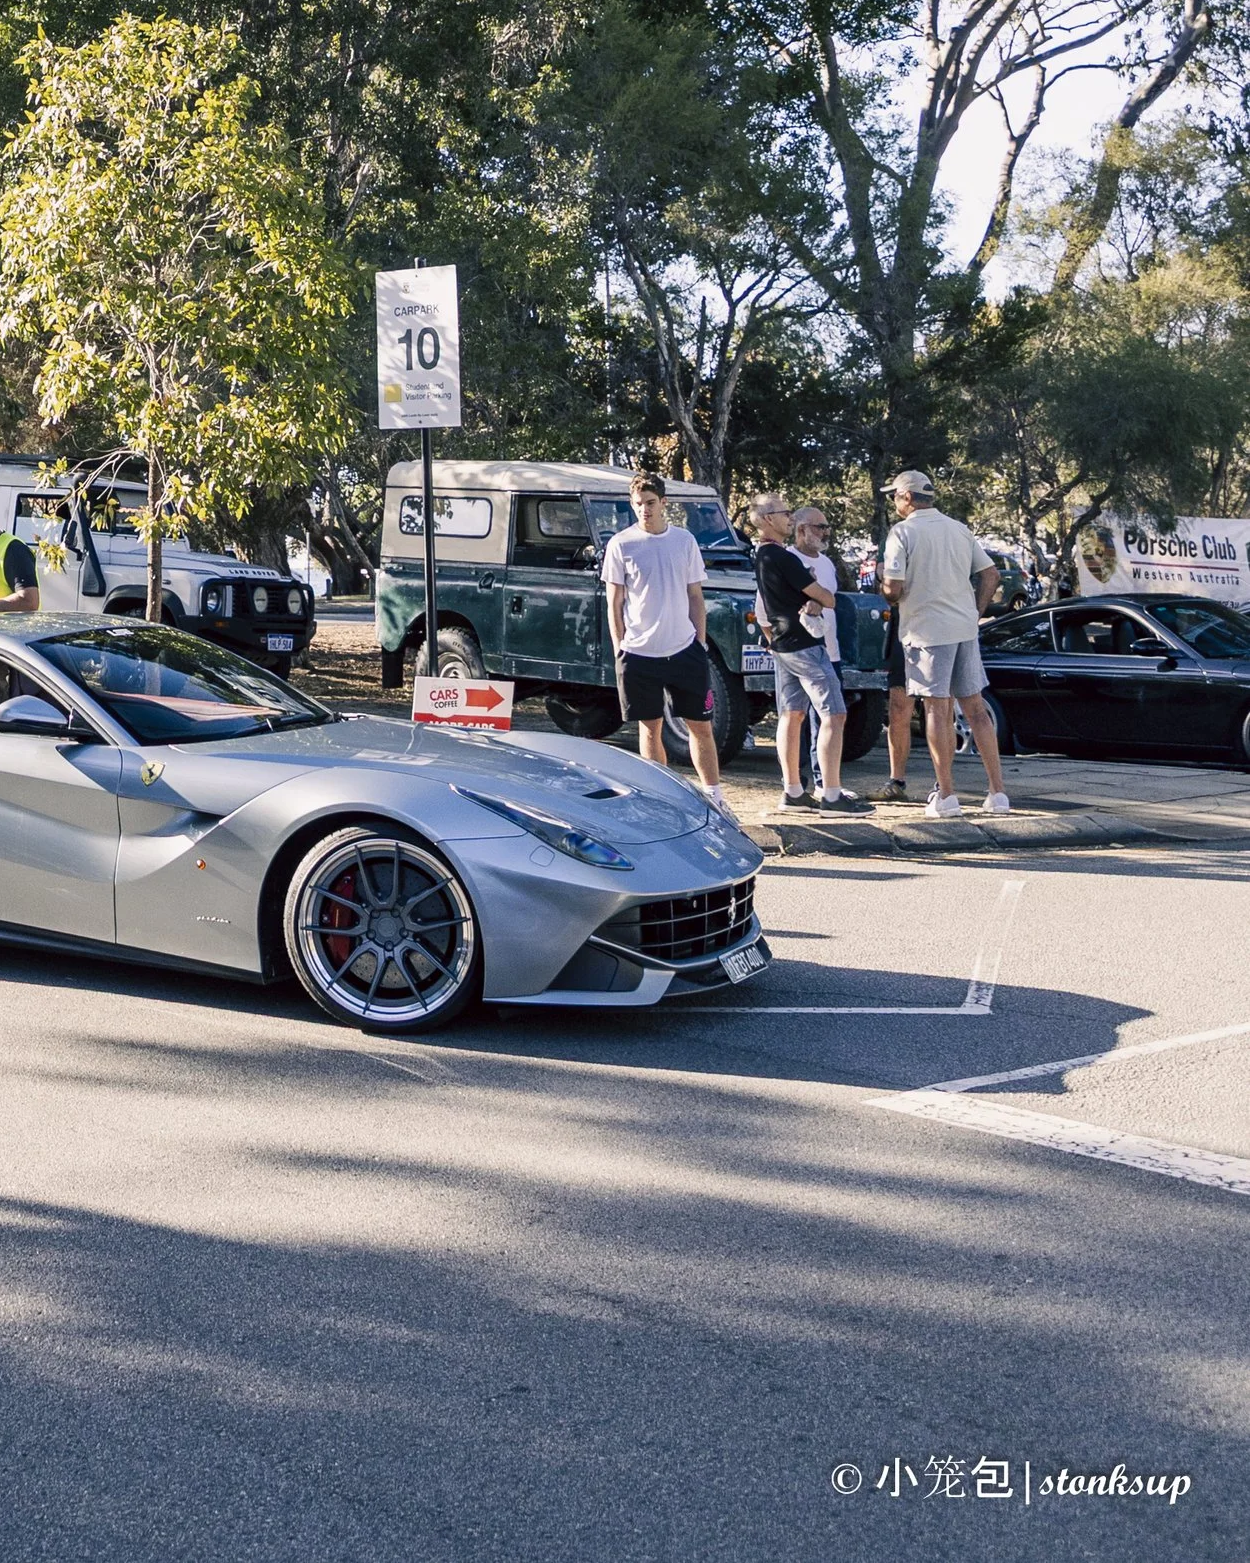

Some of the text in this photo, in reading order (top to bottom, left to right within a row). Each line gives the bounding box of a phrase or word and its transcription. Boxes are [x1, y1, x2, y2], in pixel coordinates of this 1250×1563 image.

[394, 304, 440, 317] CARPARK
[397, 327, 441, 371] 10
[427, 392, 452, 401] Prking
[1124, 529, 1237, 561] Porsche Club
[1132, 567, 1240, 586] Western Australia
[430, 688, 459, 701] CARS
[434, 700, 458, 709] COFFEE
